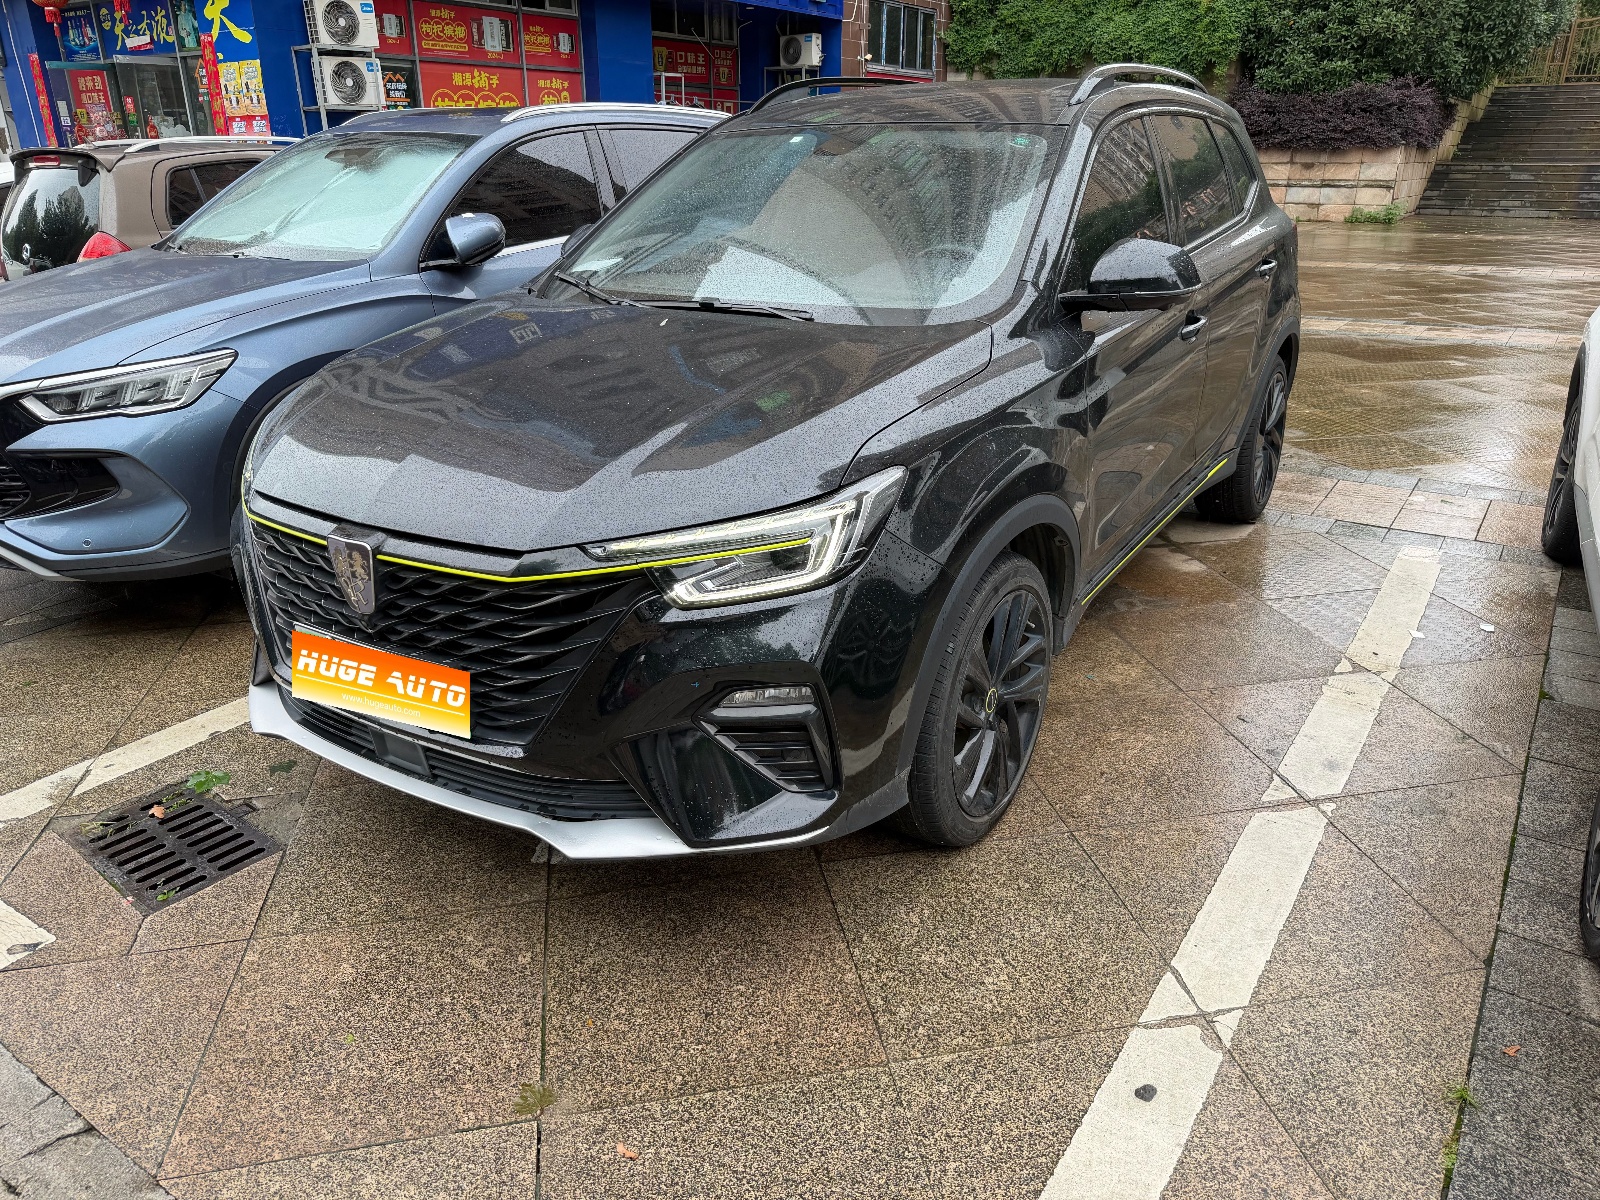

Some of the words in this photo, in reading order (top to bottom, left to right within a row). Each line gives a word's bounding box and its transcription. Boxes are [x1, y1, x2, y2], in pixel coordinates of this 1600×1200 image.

[420, 22, 466, 38] 枸杞槟榔
[677, 52, 706, 65] 口味王
